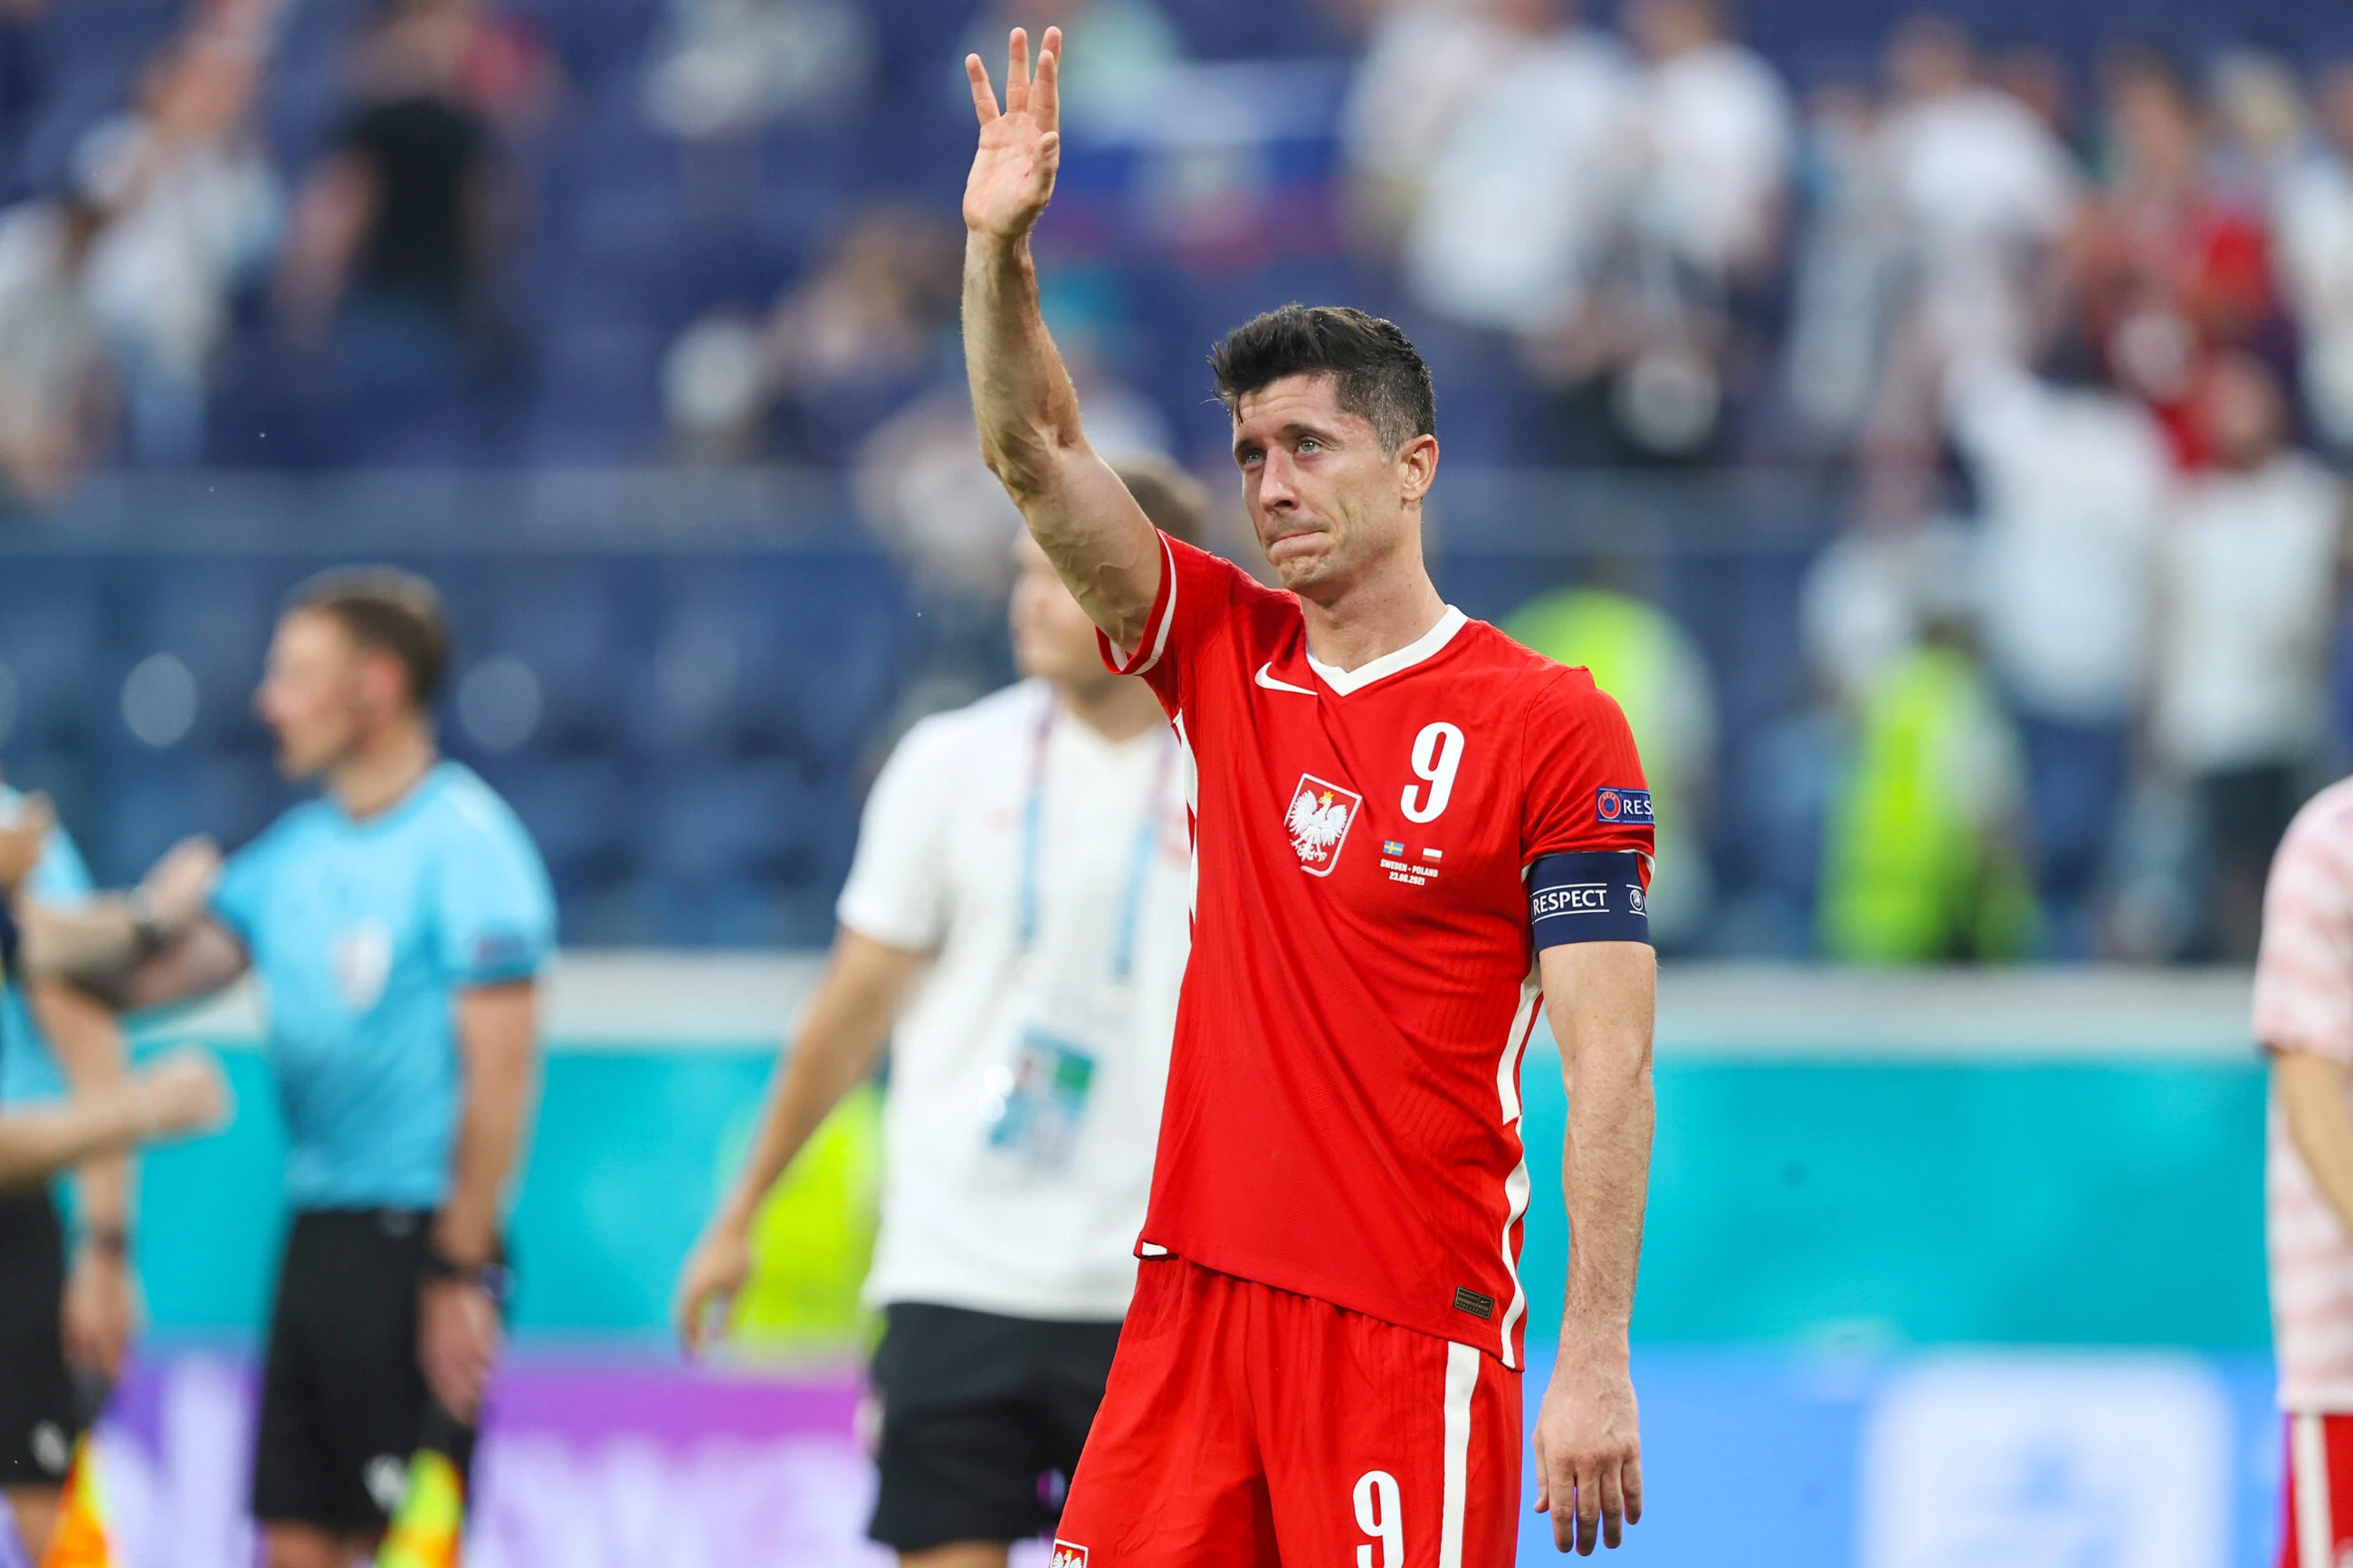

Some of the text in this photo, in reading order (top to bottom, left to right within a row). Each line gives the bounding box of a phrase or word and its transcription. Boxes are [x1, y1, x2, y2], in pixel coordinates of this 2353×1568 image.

[1400, 722, 1465, 823] 9
[1623, 799, 1654, 815] RES
[1380, 859, 1408, 871] SWEDEN
[1412, 865, 1439, 878] POLAND
[1533, 889, 1607, 916] RESPECT
[1352, 1470, 1405, 1568] 9
